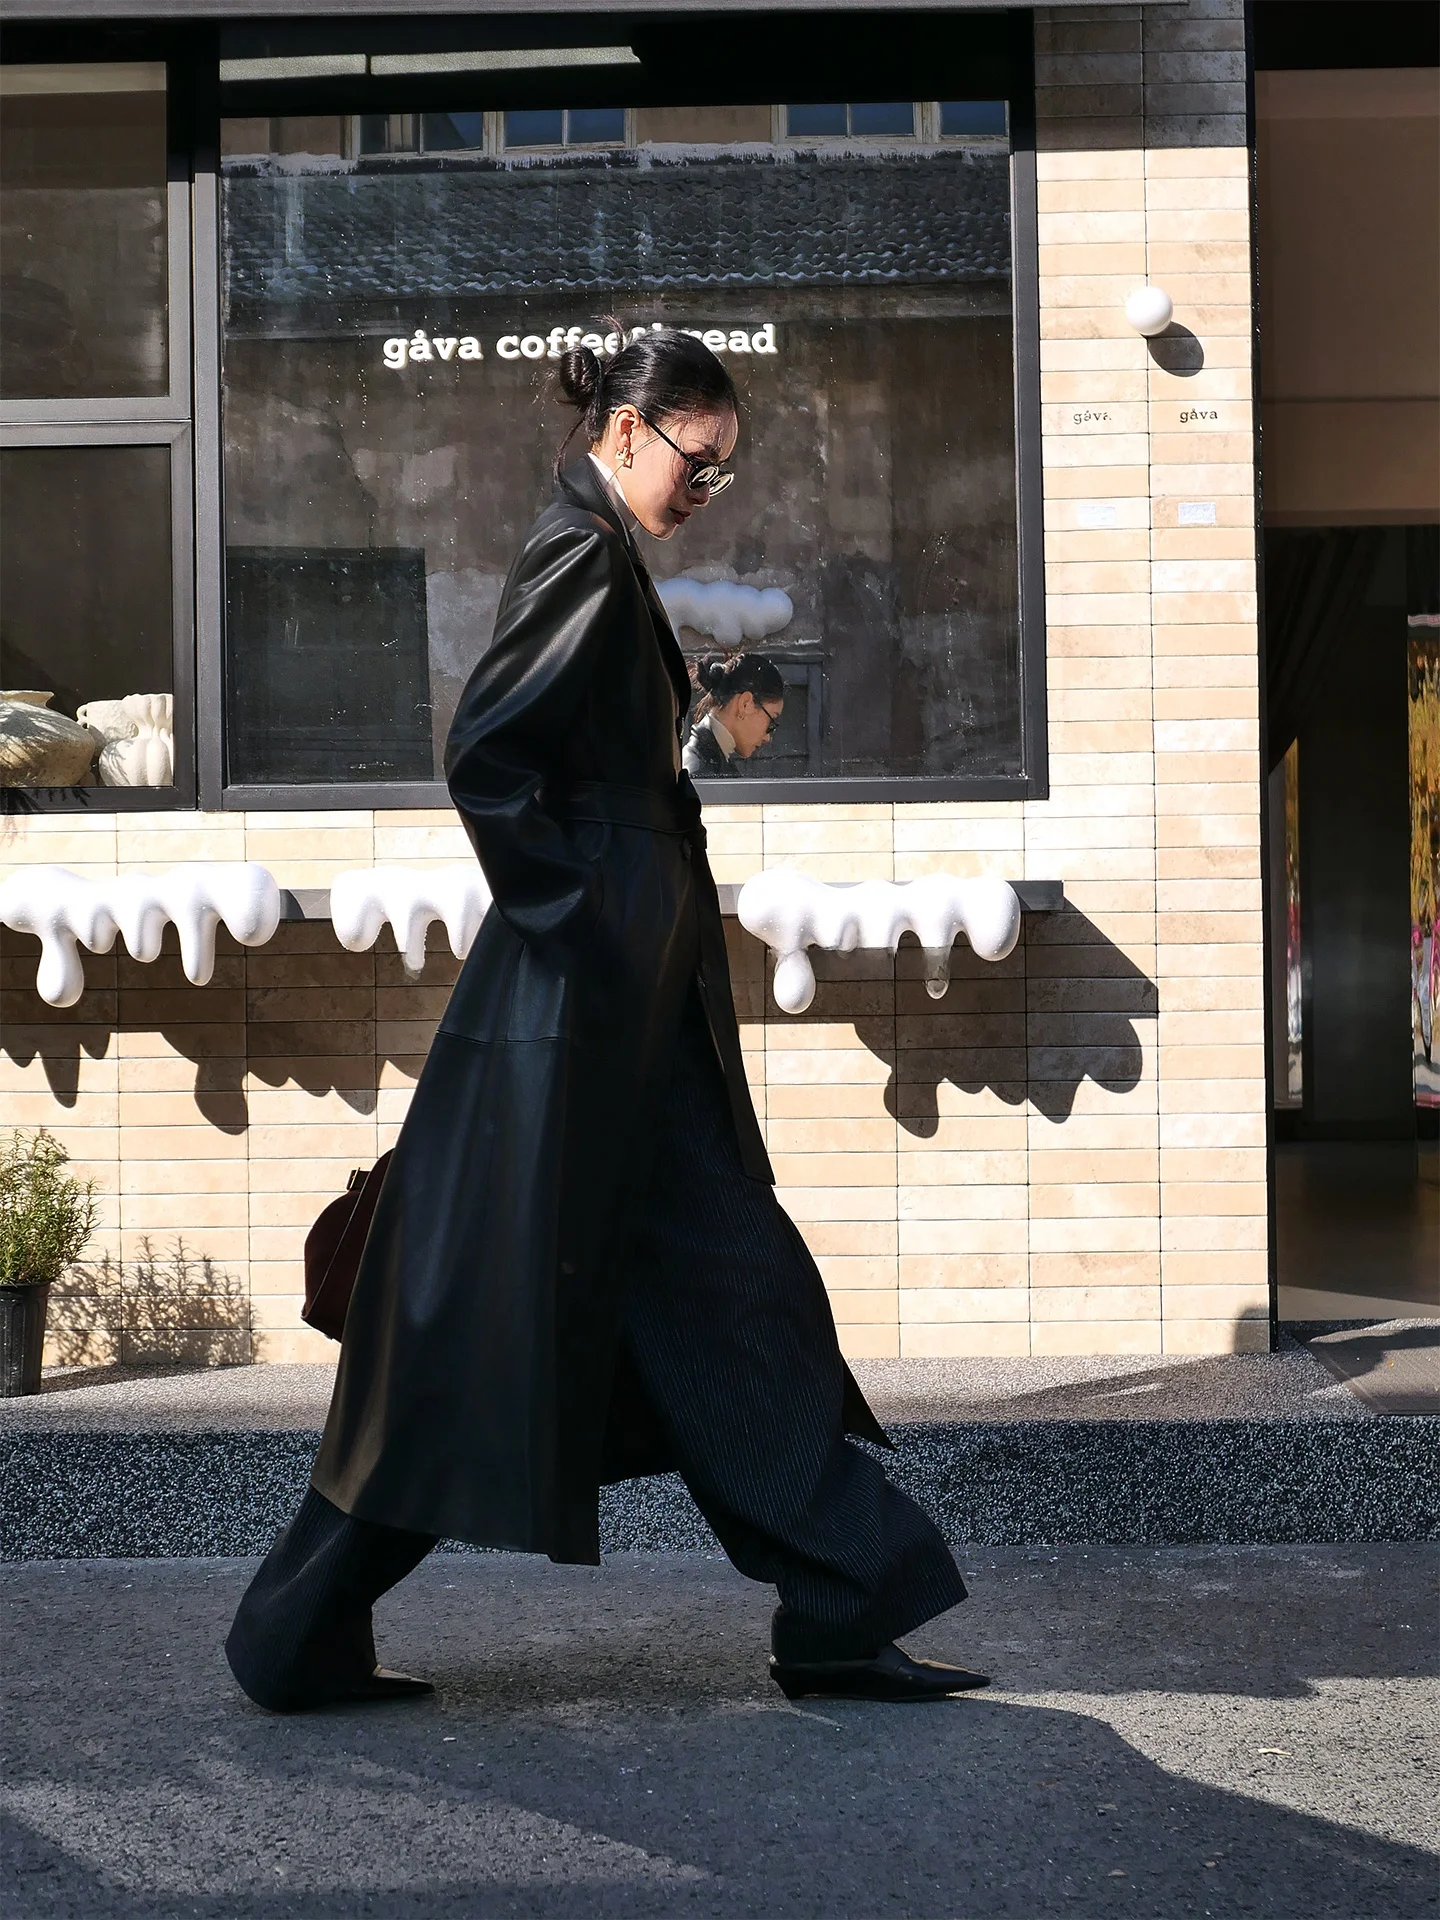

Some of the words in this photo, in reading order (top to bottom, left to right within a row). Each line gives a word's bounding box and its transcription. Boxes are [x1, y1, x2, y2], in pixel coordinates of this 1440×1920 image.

[383, 329, 483, 369] gåva
[496, 323, 777, 360] coffeeead
[1179, 408, 1218, 424] gåva
